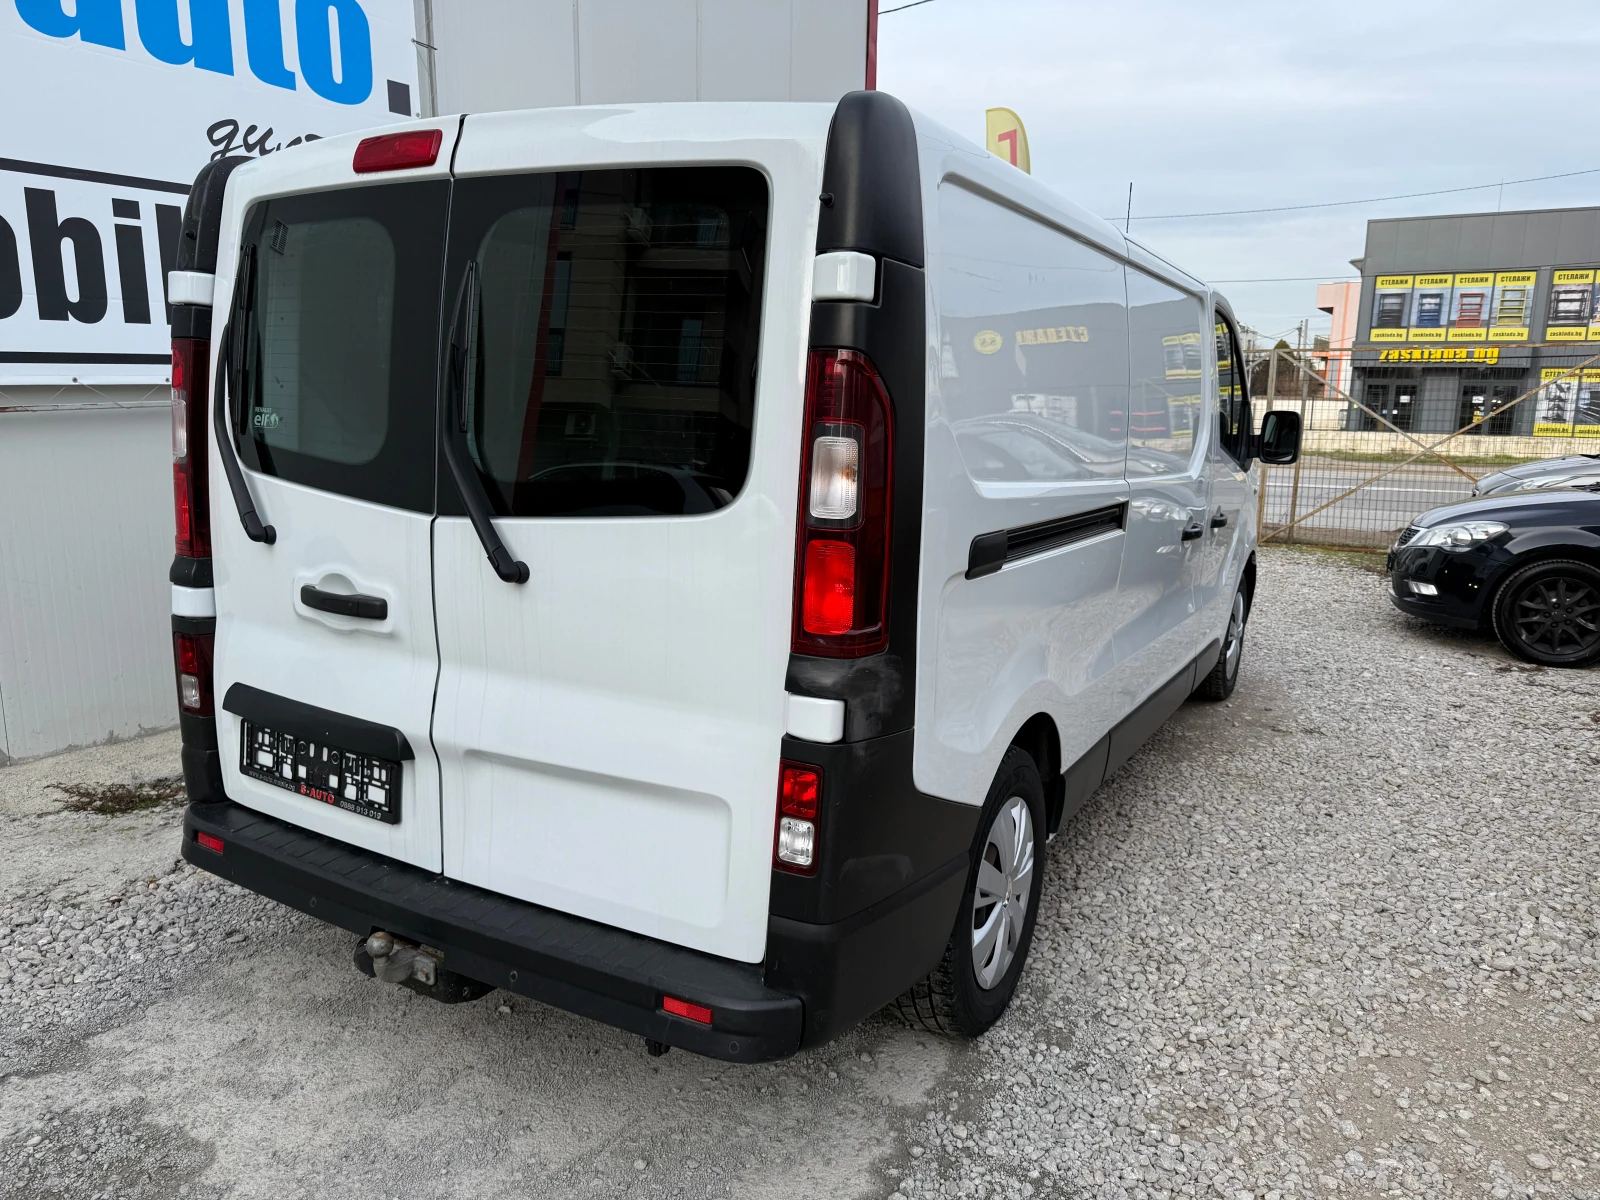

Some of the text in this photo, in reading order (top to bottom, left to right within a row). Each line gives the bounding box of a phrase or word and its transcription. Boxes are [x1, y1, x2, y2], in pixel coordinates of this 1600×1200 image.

[1459, 276, 1489, 284] СТЕЛАЖИ
[1500, 275, 1531, 283] СТЕЛАЖИ
[1557, 273, 1590, 281] СТЕЛАЖИ
[1380, 278, 1409, 286] СТЕЛАЖИ
[254, 413, 270, 426] elf
[300, 784, 335, 804] S-AUTO
[356, 804, 369, 816] 913
